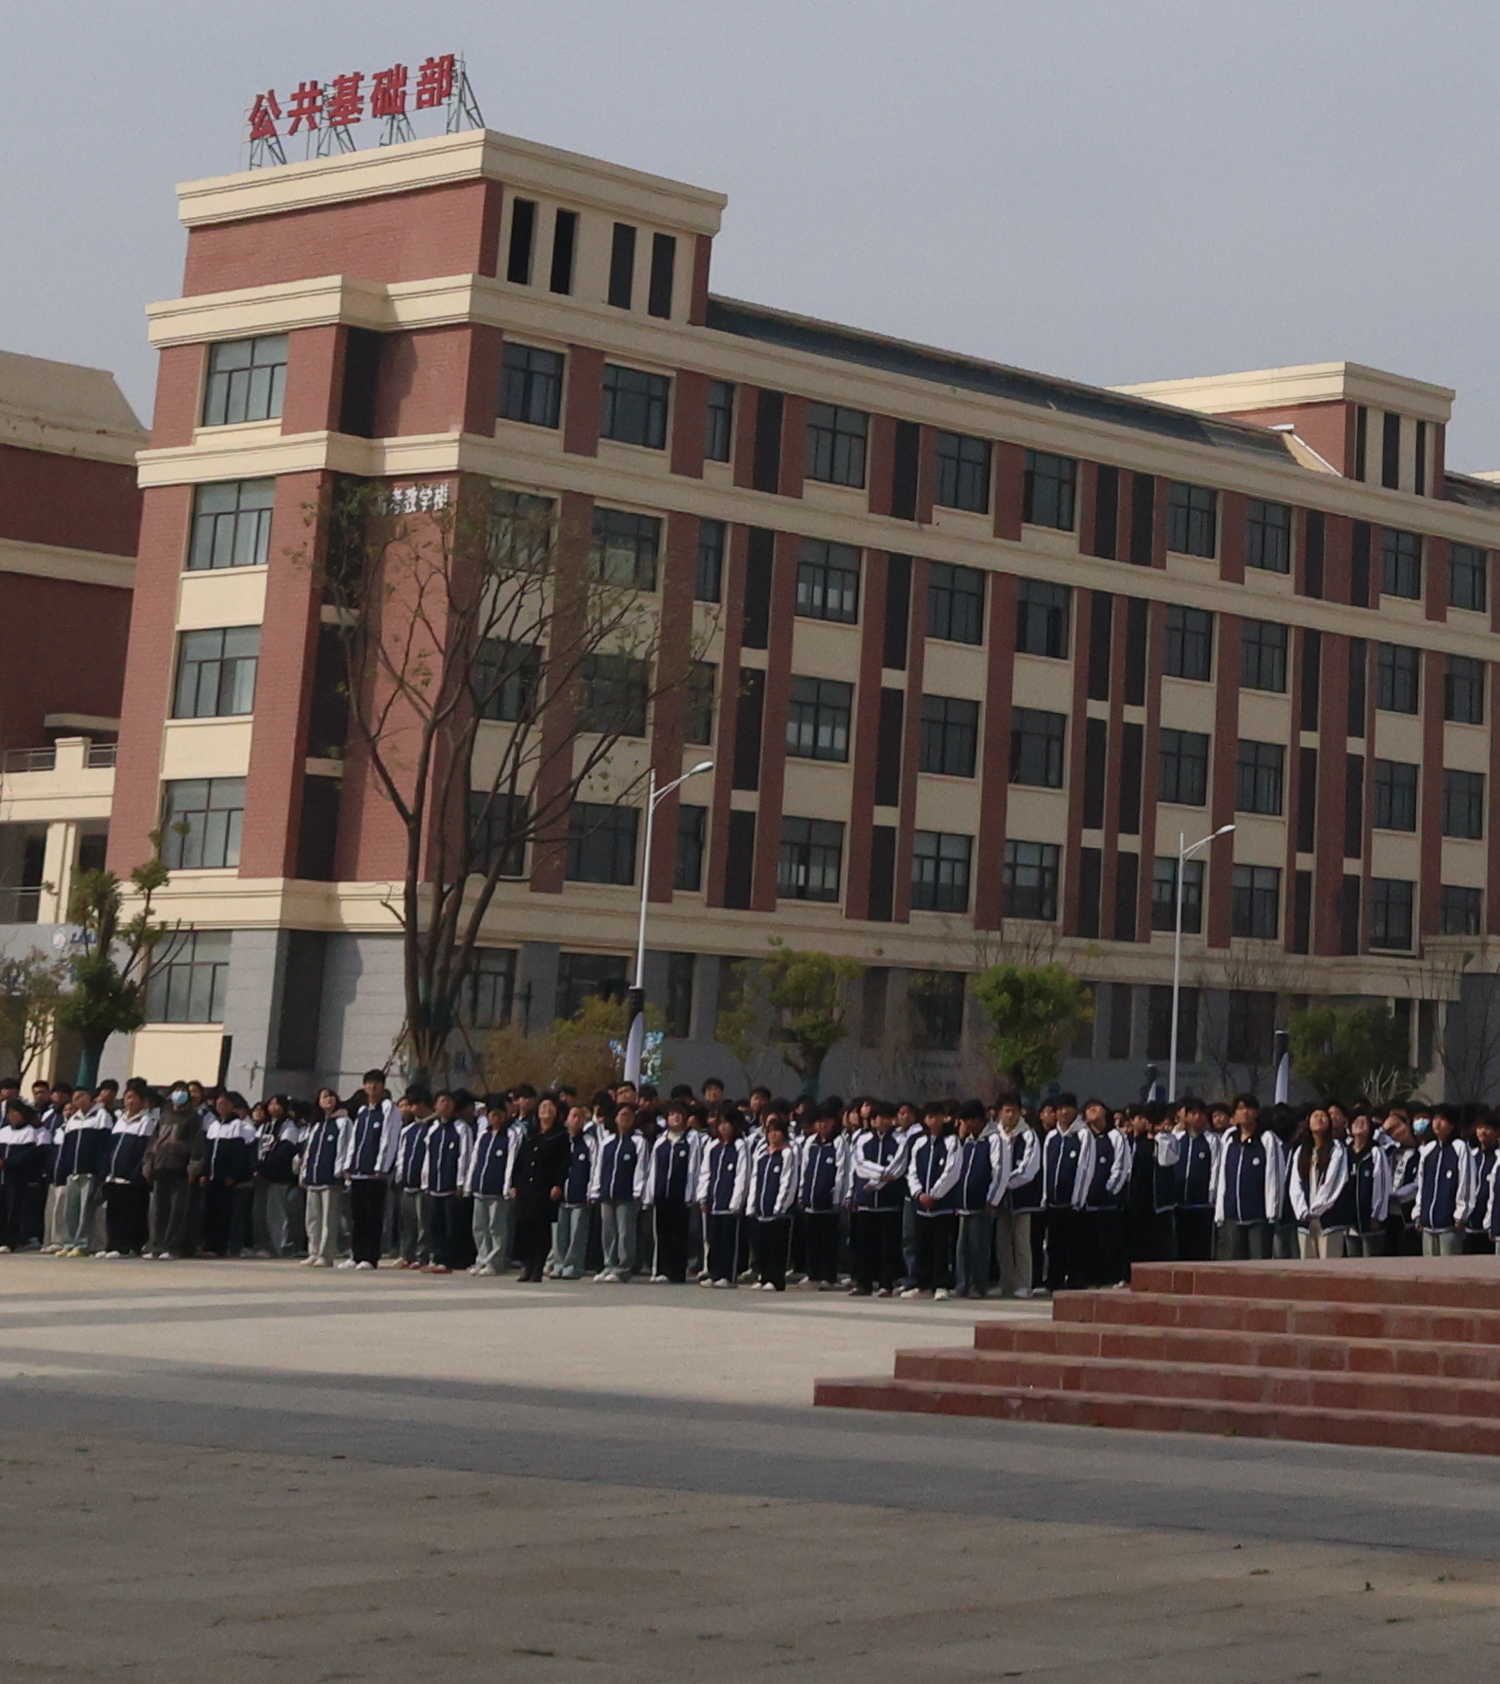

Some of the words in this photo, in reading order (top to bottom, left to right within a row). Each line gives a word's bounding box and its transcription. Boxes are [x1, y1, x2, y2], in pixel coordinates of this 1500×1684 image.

[248, 54, 455, 141] 公共基础部
